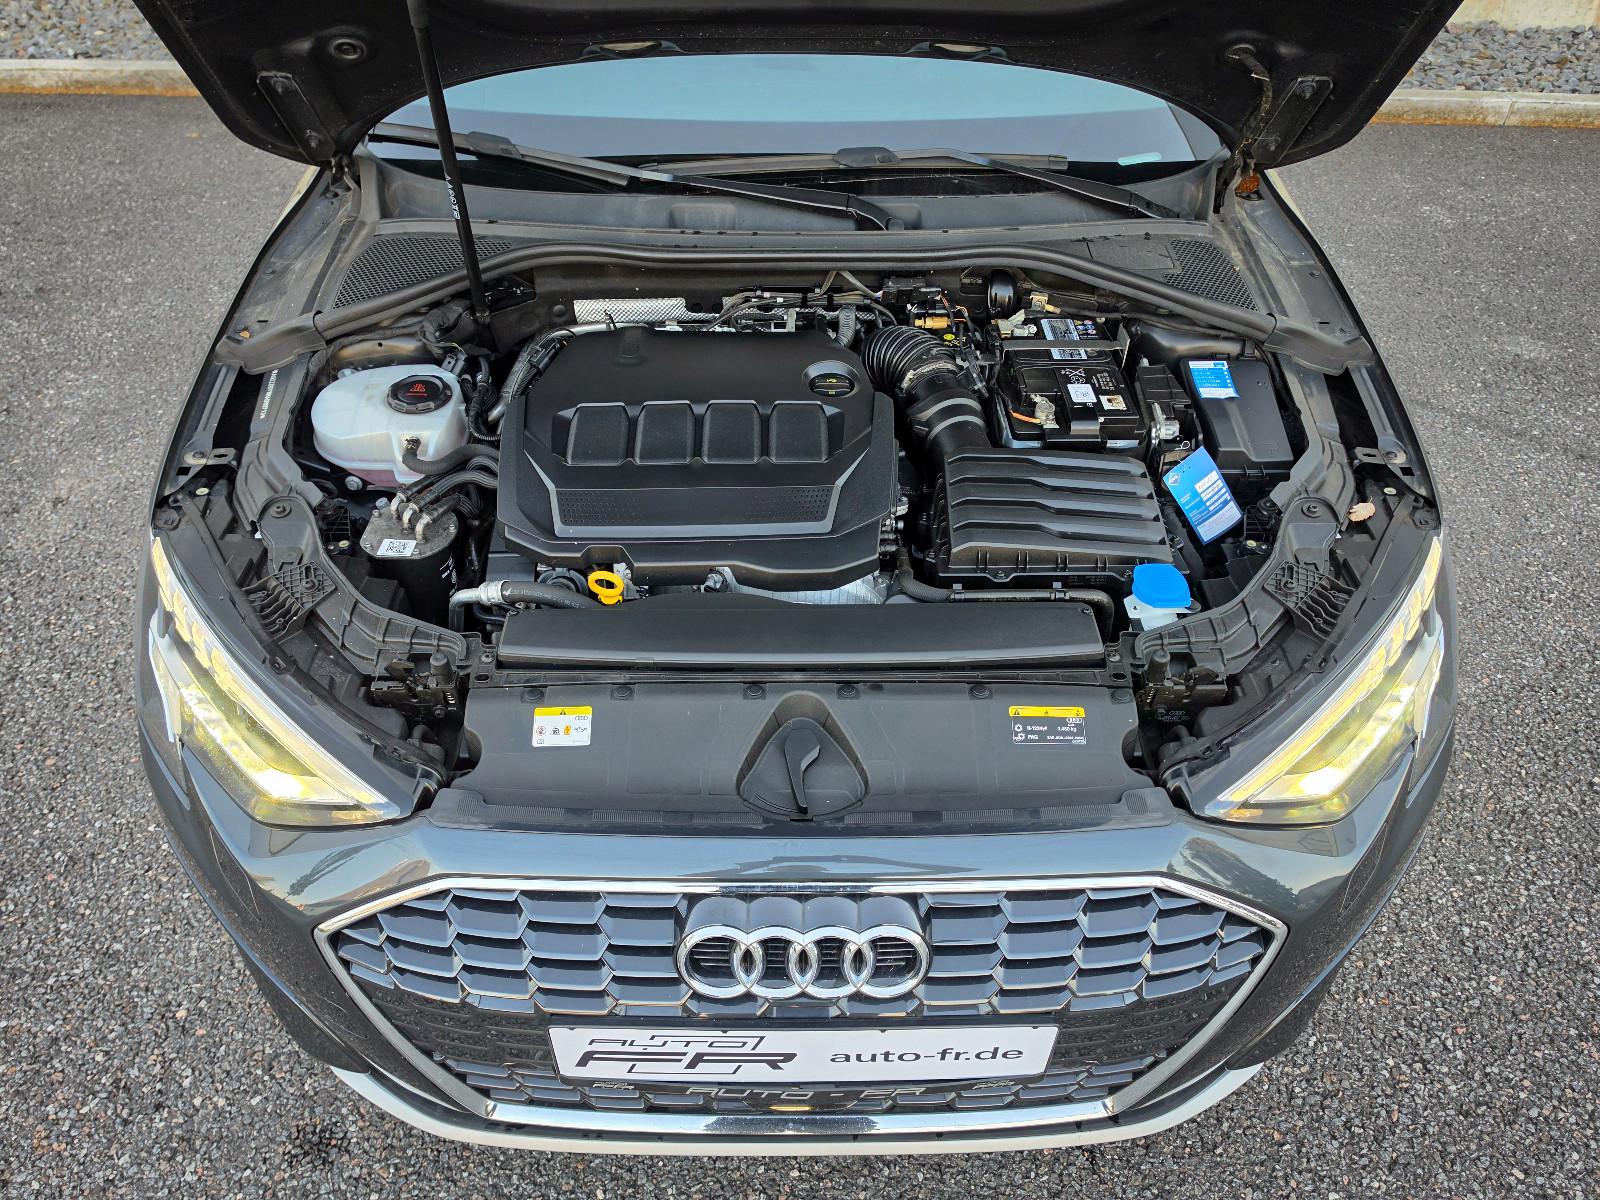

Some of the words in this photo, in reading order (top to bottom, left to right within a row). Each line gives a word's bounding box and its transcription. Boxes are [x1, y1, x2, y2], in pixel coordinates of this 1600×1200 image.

[588, 1038, 748, 1049] AUTO
[829, 1044, 1025, 1064] auto-fr.de
[686, 1087, 816, 1100] AUTO
